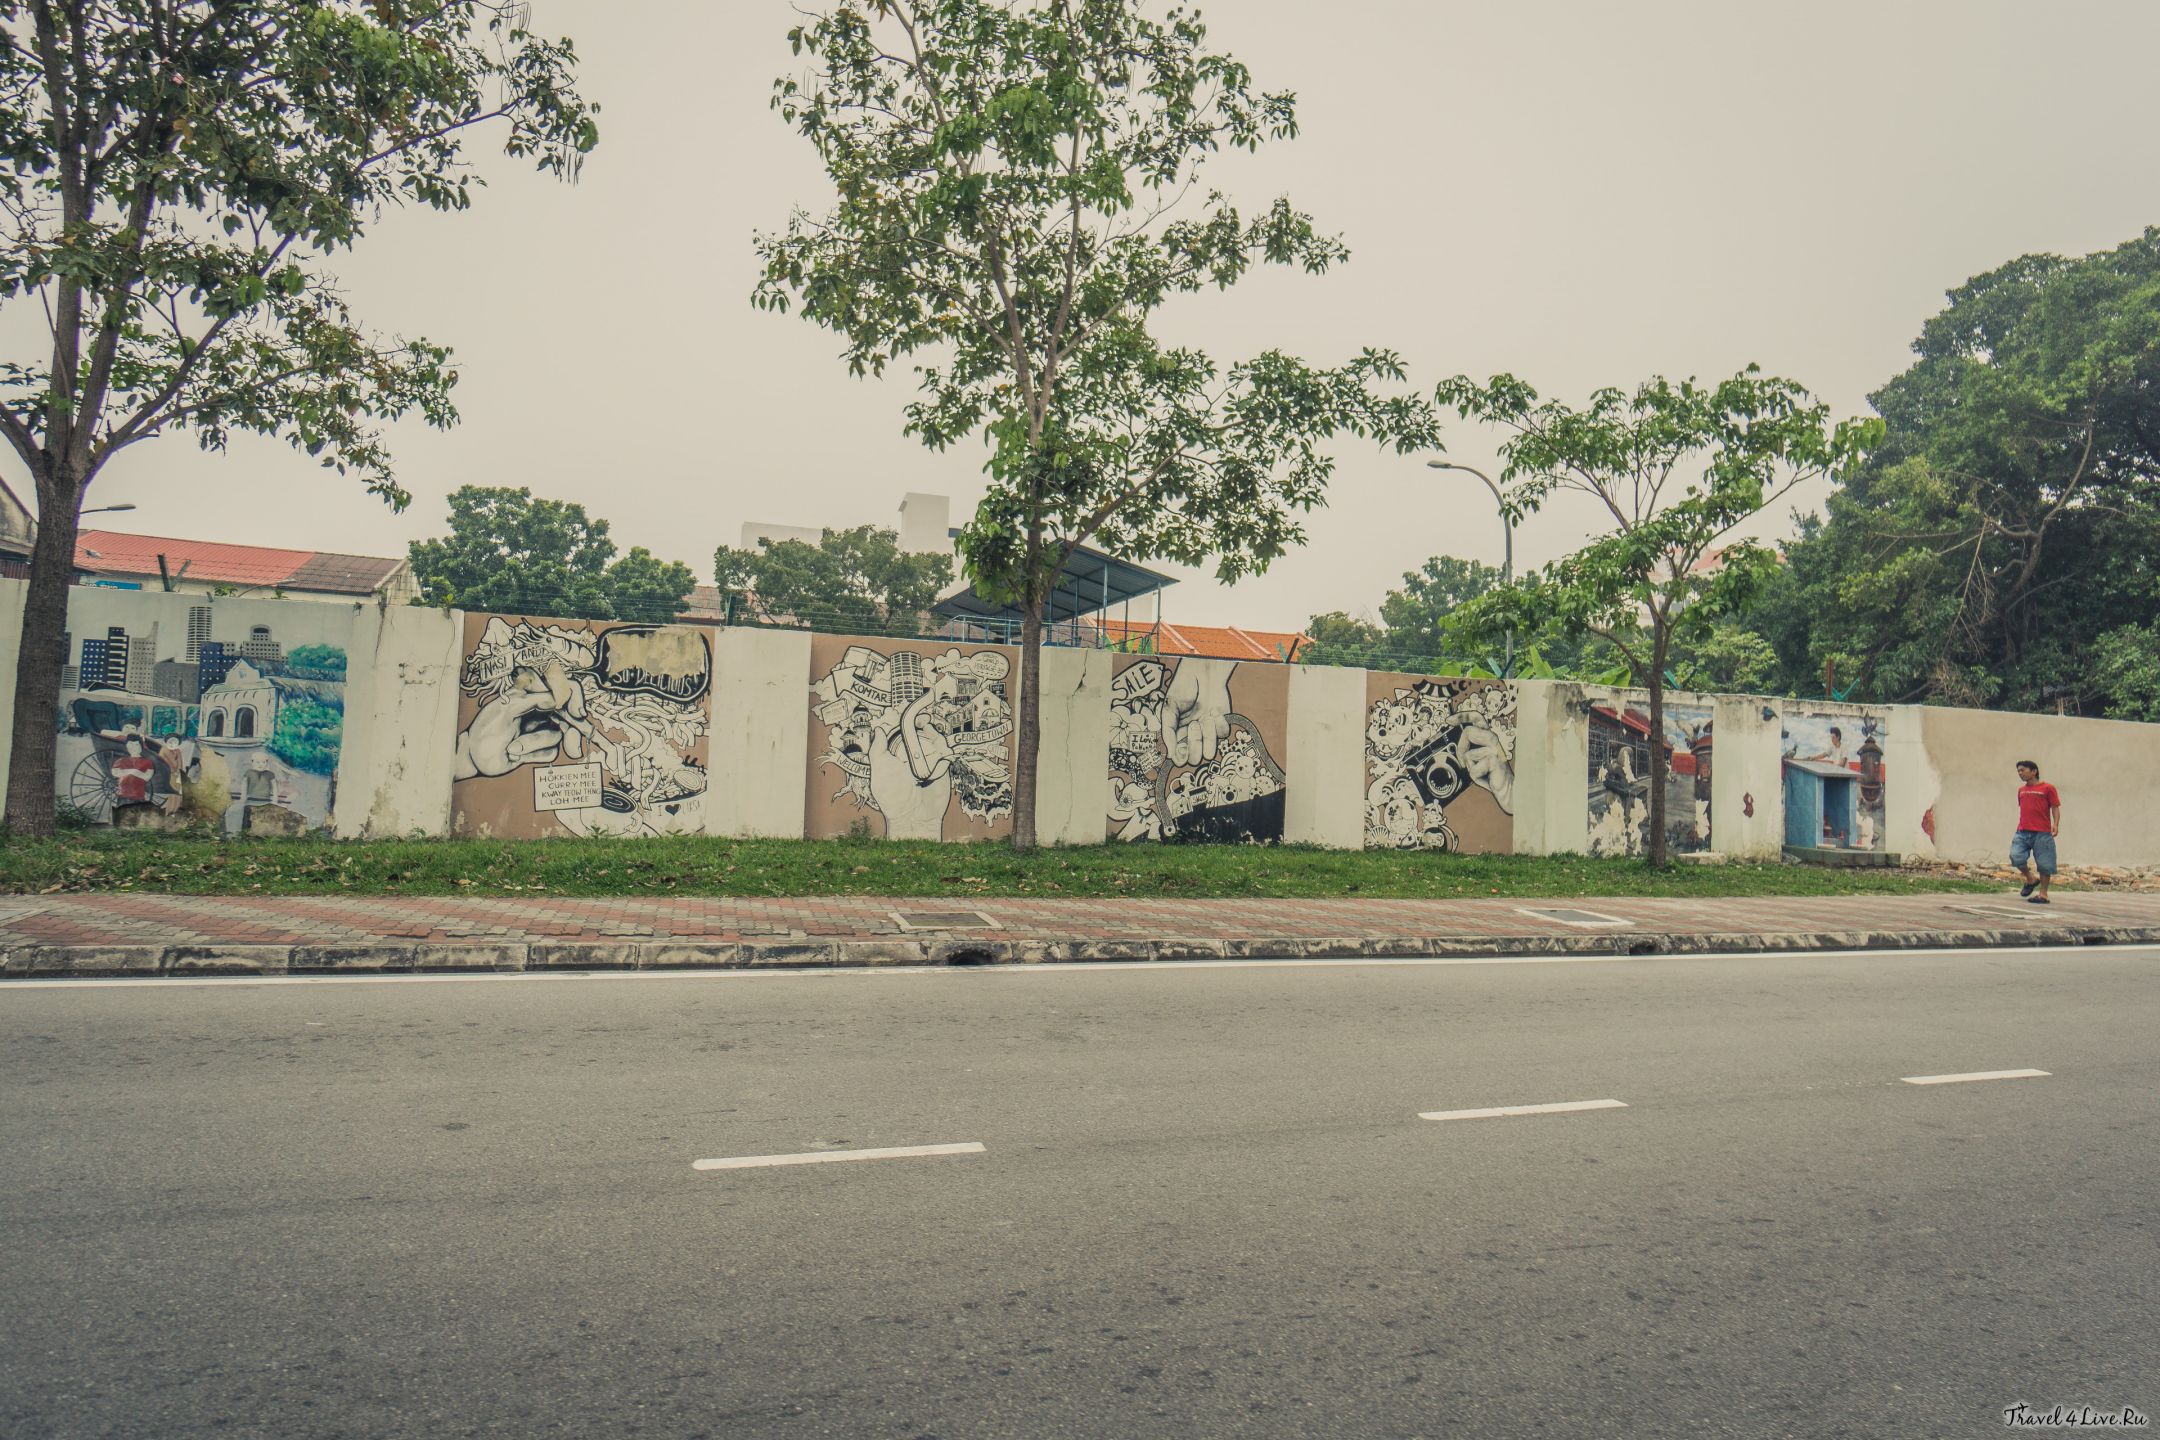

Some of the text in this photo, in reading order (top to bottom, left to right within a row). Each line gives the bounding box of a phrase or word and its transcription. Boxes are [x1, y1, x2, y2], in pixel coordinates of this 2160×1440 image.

[1112, 663, 1155, 701] SALE
[850, 682, 887, 703] KOMTAR
[837, 755, 871, 776] WELCOME
[540, 771, 596, 783] HOKKIEN MEE
[548, 780, 596, 790] CURRY MEE
[542, 790, 561, 798] KWAY
[550, 798, 569, 806] LOH
